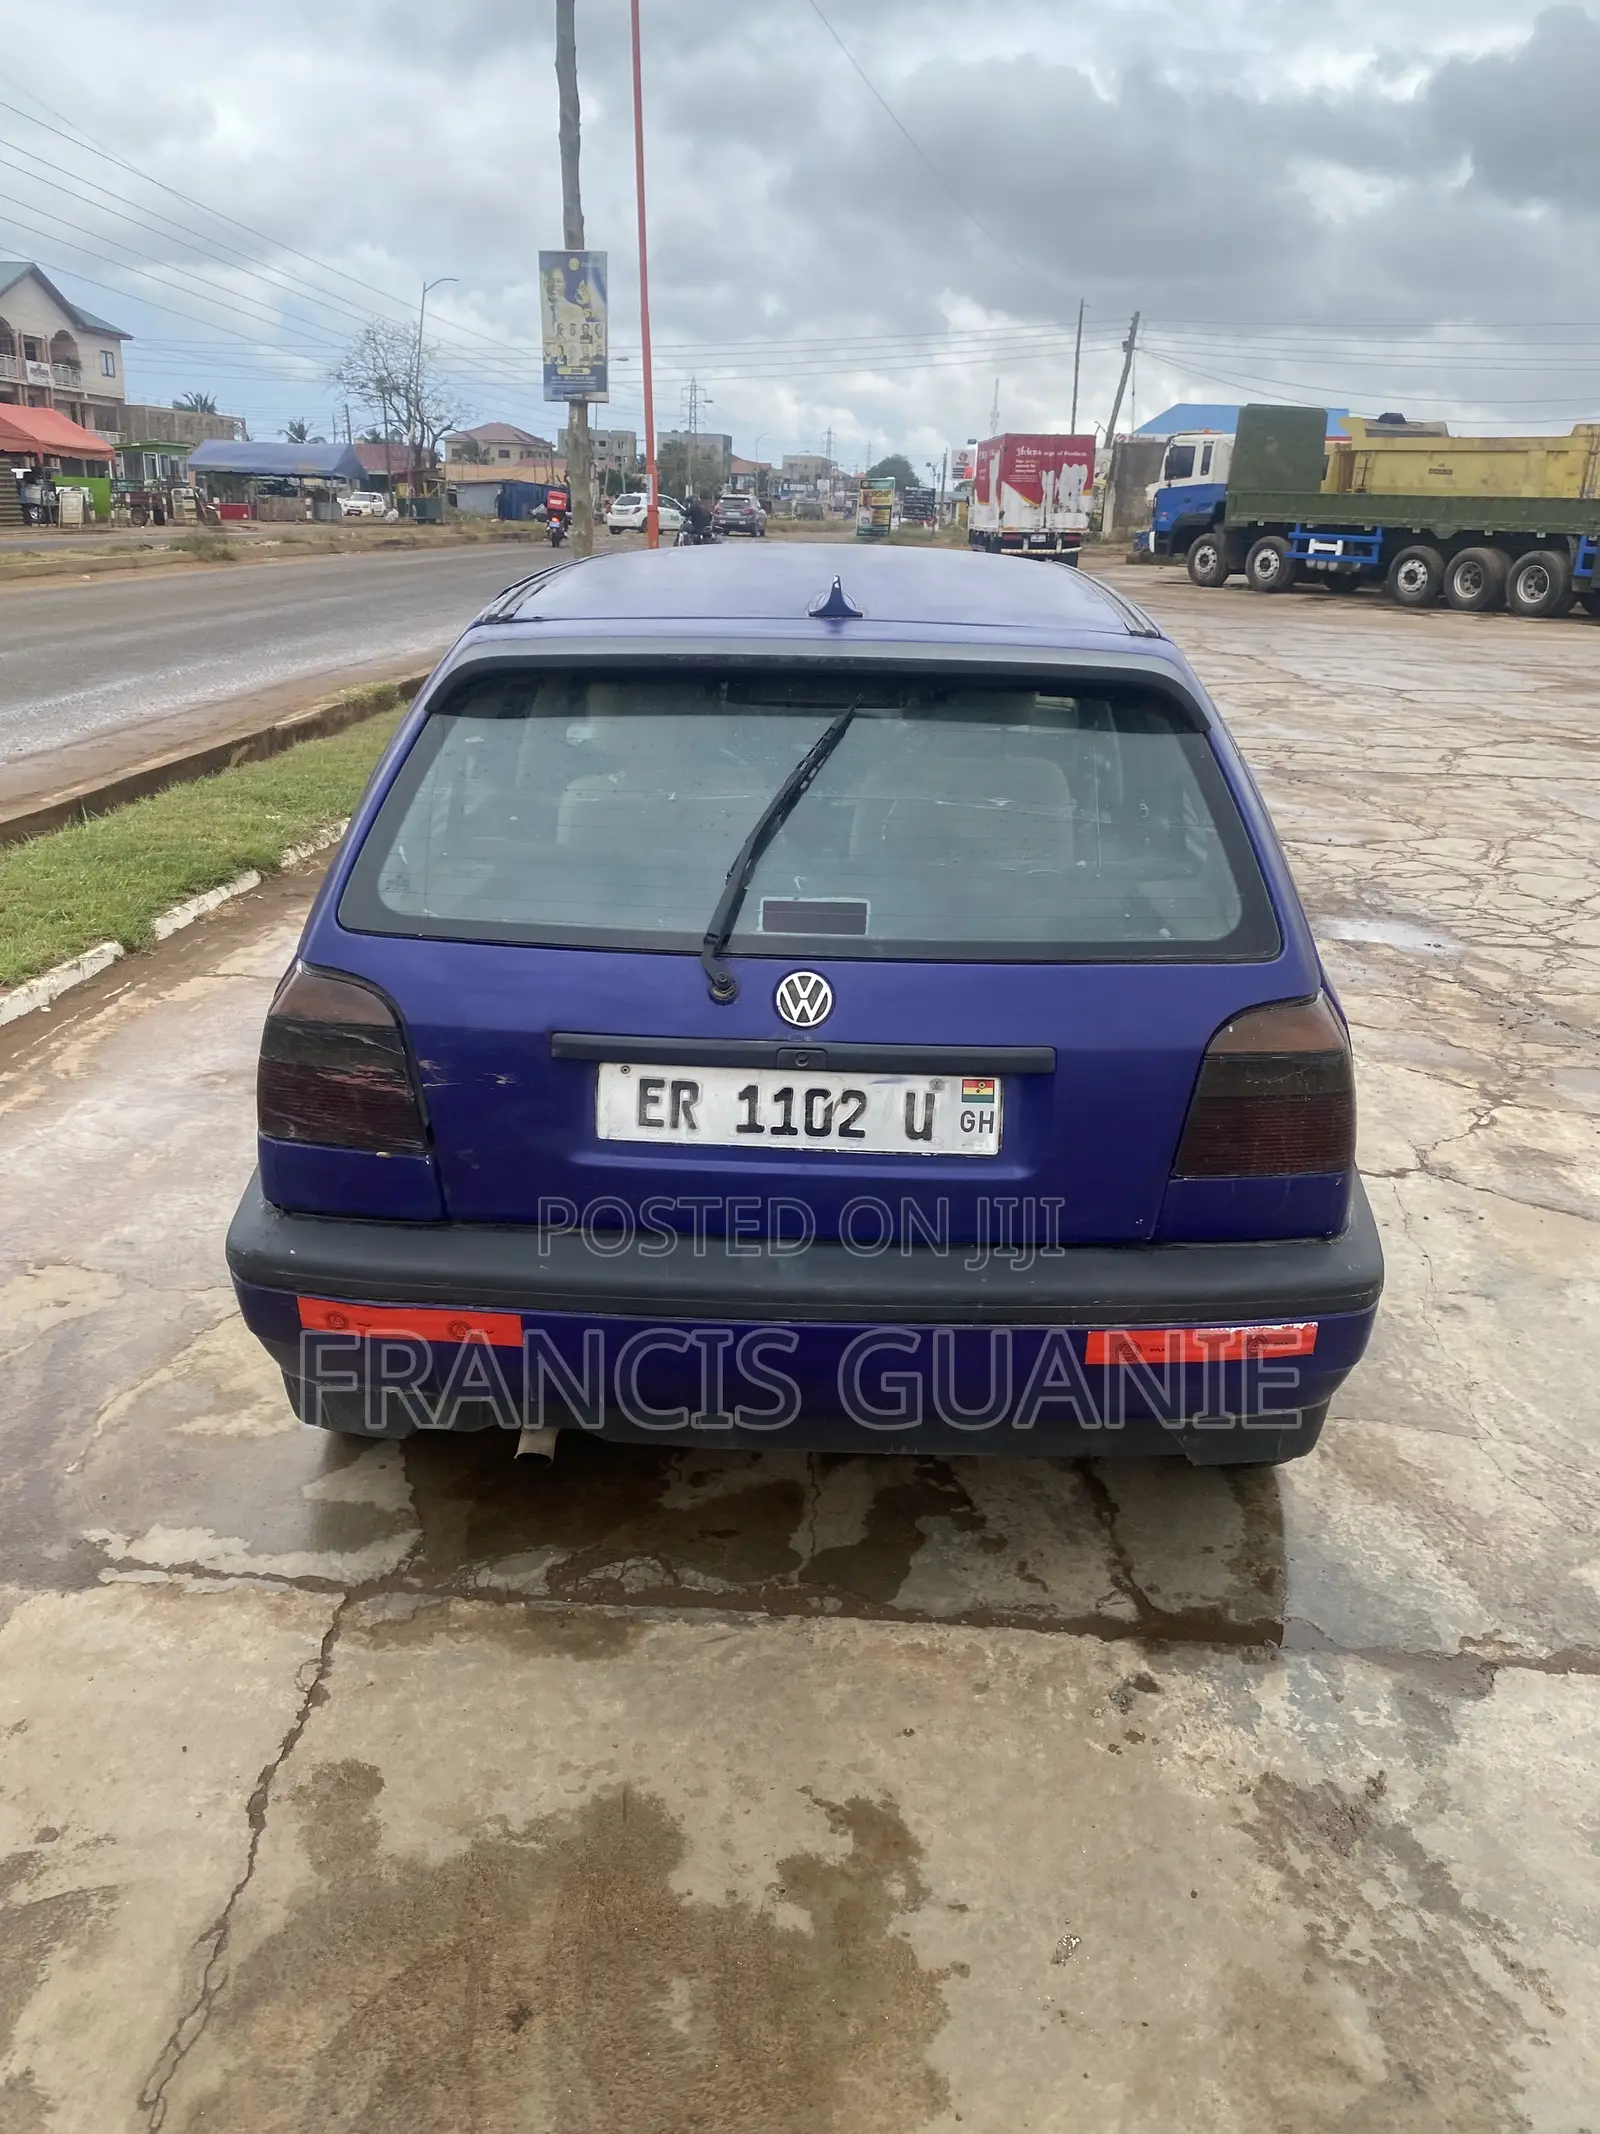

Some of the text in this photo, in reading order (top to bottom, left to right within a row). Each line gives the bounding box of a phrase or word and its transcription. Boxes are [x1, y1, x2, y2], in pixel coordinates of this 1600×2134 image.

[639, 1078, 935, 1141] ER 1102 U
[960, 1110, 995, 1134] GH
